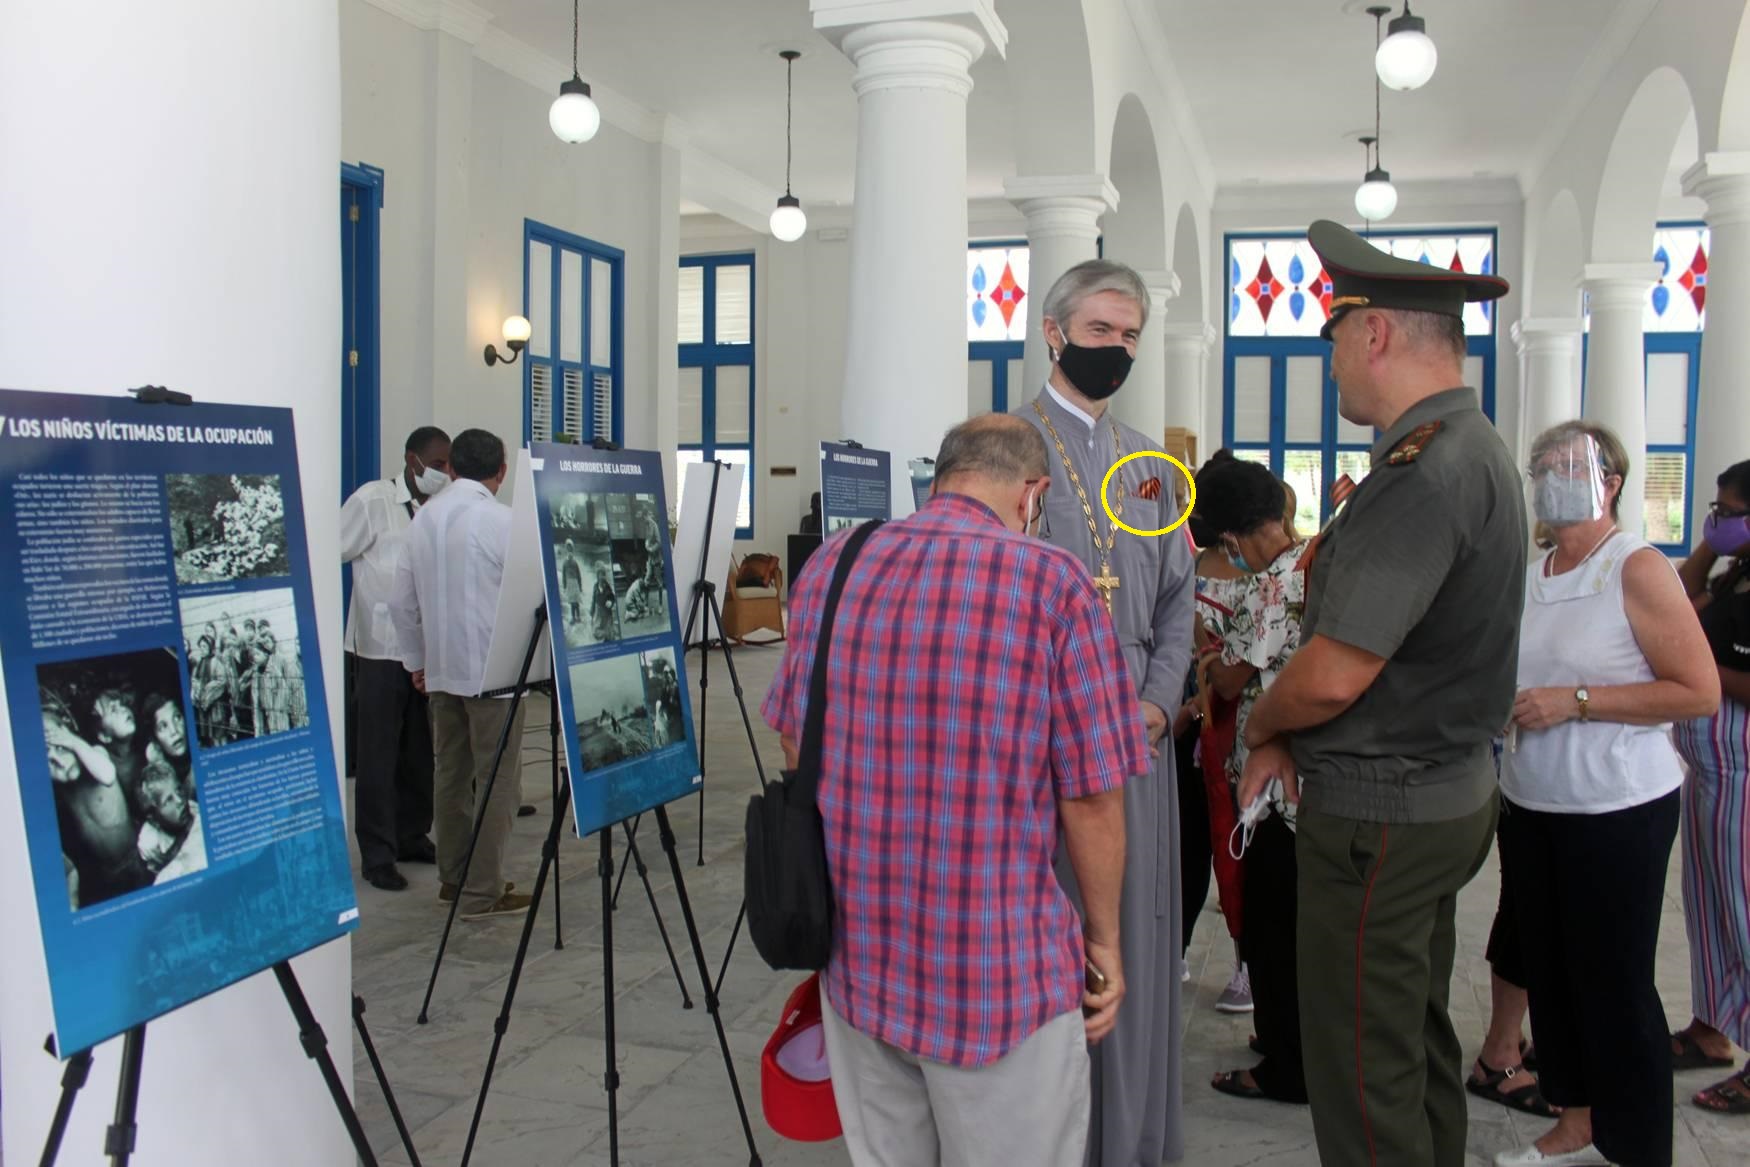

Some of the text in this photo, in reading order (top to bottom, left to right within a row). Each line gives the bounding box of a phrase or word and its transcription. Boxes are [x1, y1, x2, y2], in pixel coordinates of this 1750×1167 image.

[8, 416, 274, 445] LOS NIÑOS VÍCTIMAS DE LA OCUPACIÓN
[559, 460, 643, 475] LOS HORRORES DE LA GUERRA
